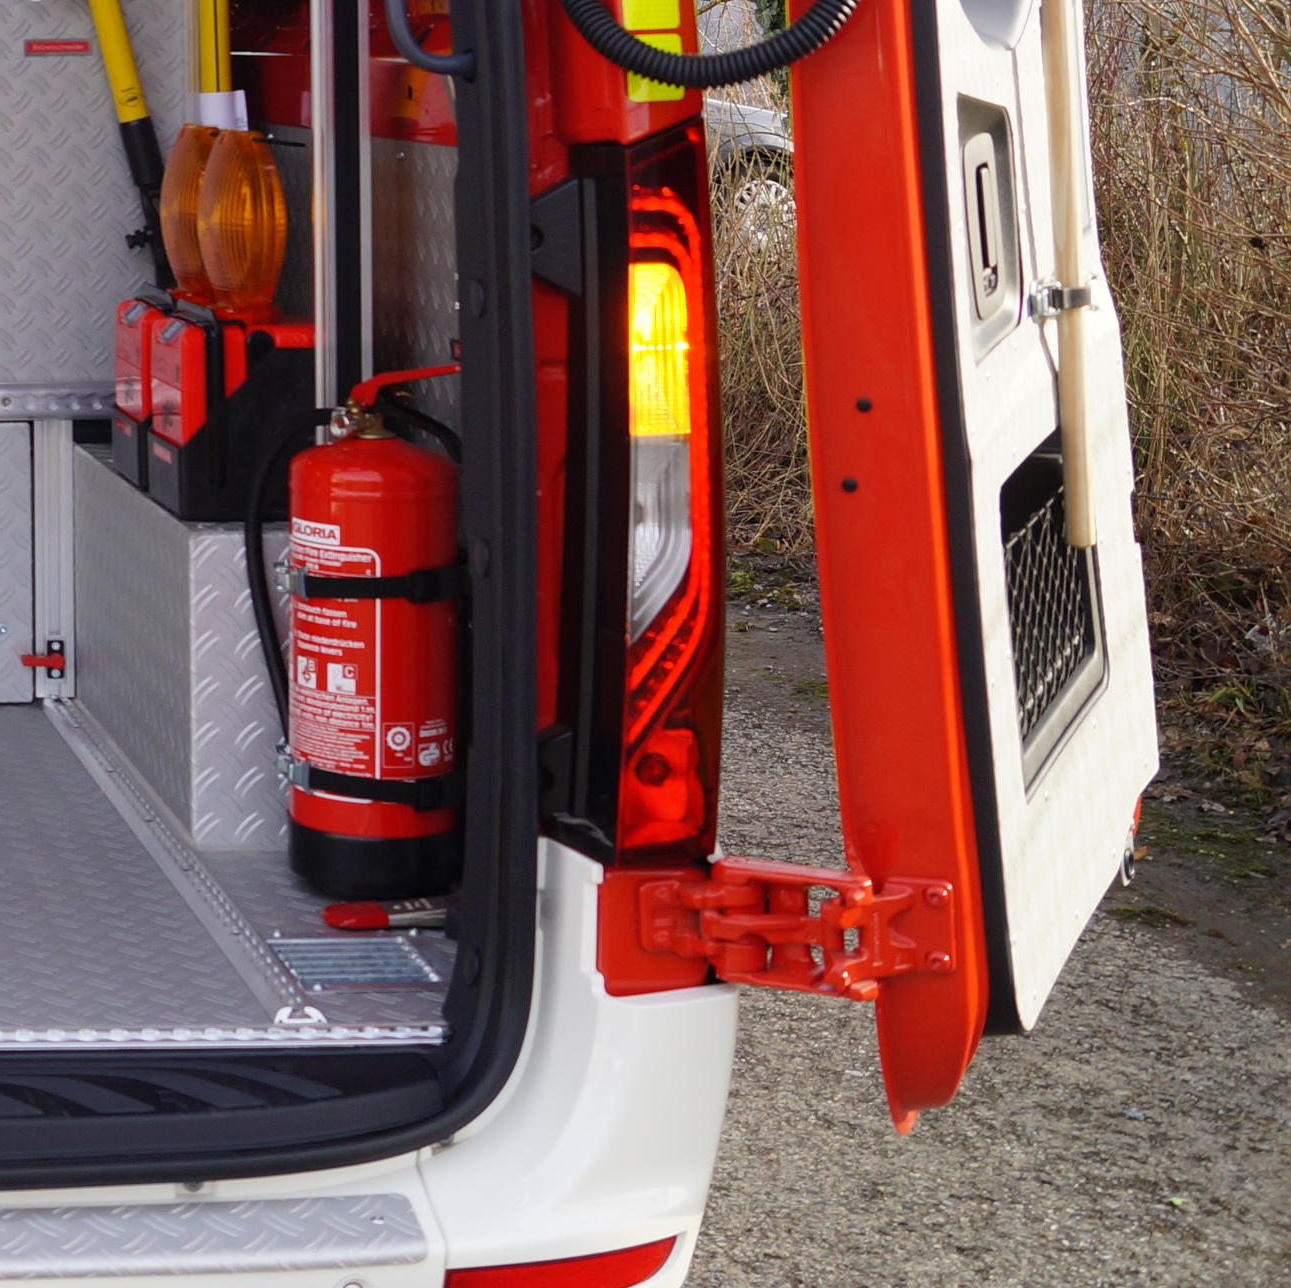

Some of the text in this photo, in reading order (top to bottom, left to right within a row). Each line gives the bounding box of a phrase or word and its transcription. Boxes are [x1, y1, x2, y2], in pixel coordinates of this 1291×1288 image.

[292, 521, 337, 540] GLORIA
[320, 550, 372, 562] Extinguisher
[342, 620, 357, 629] fire
[307, 660, 316, 672] B
[344, 666, 355, 678] C
